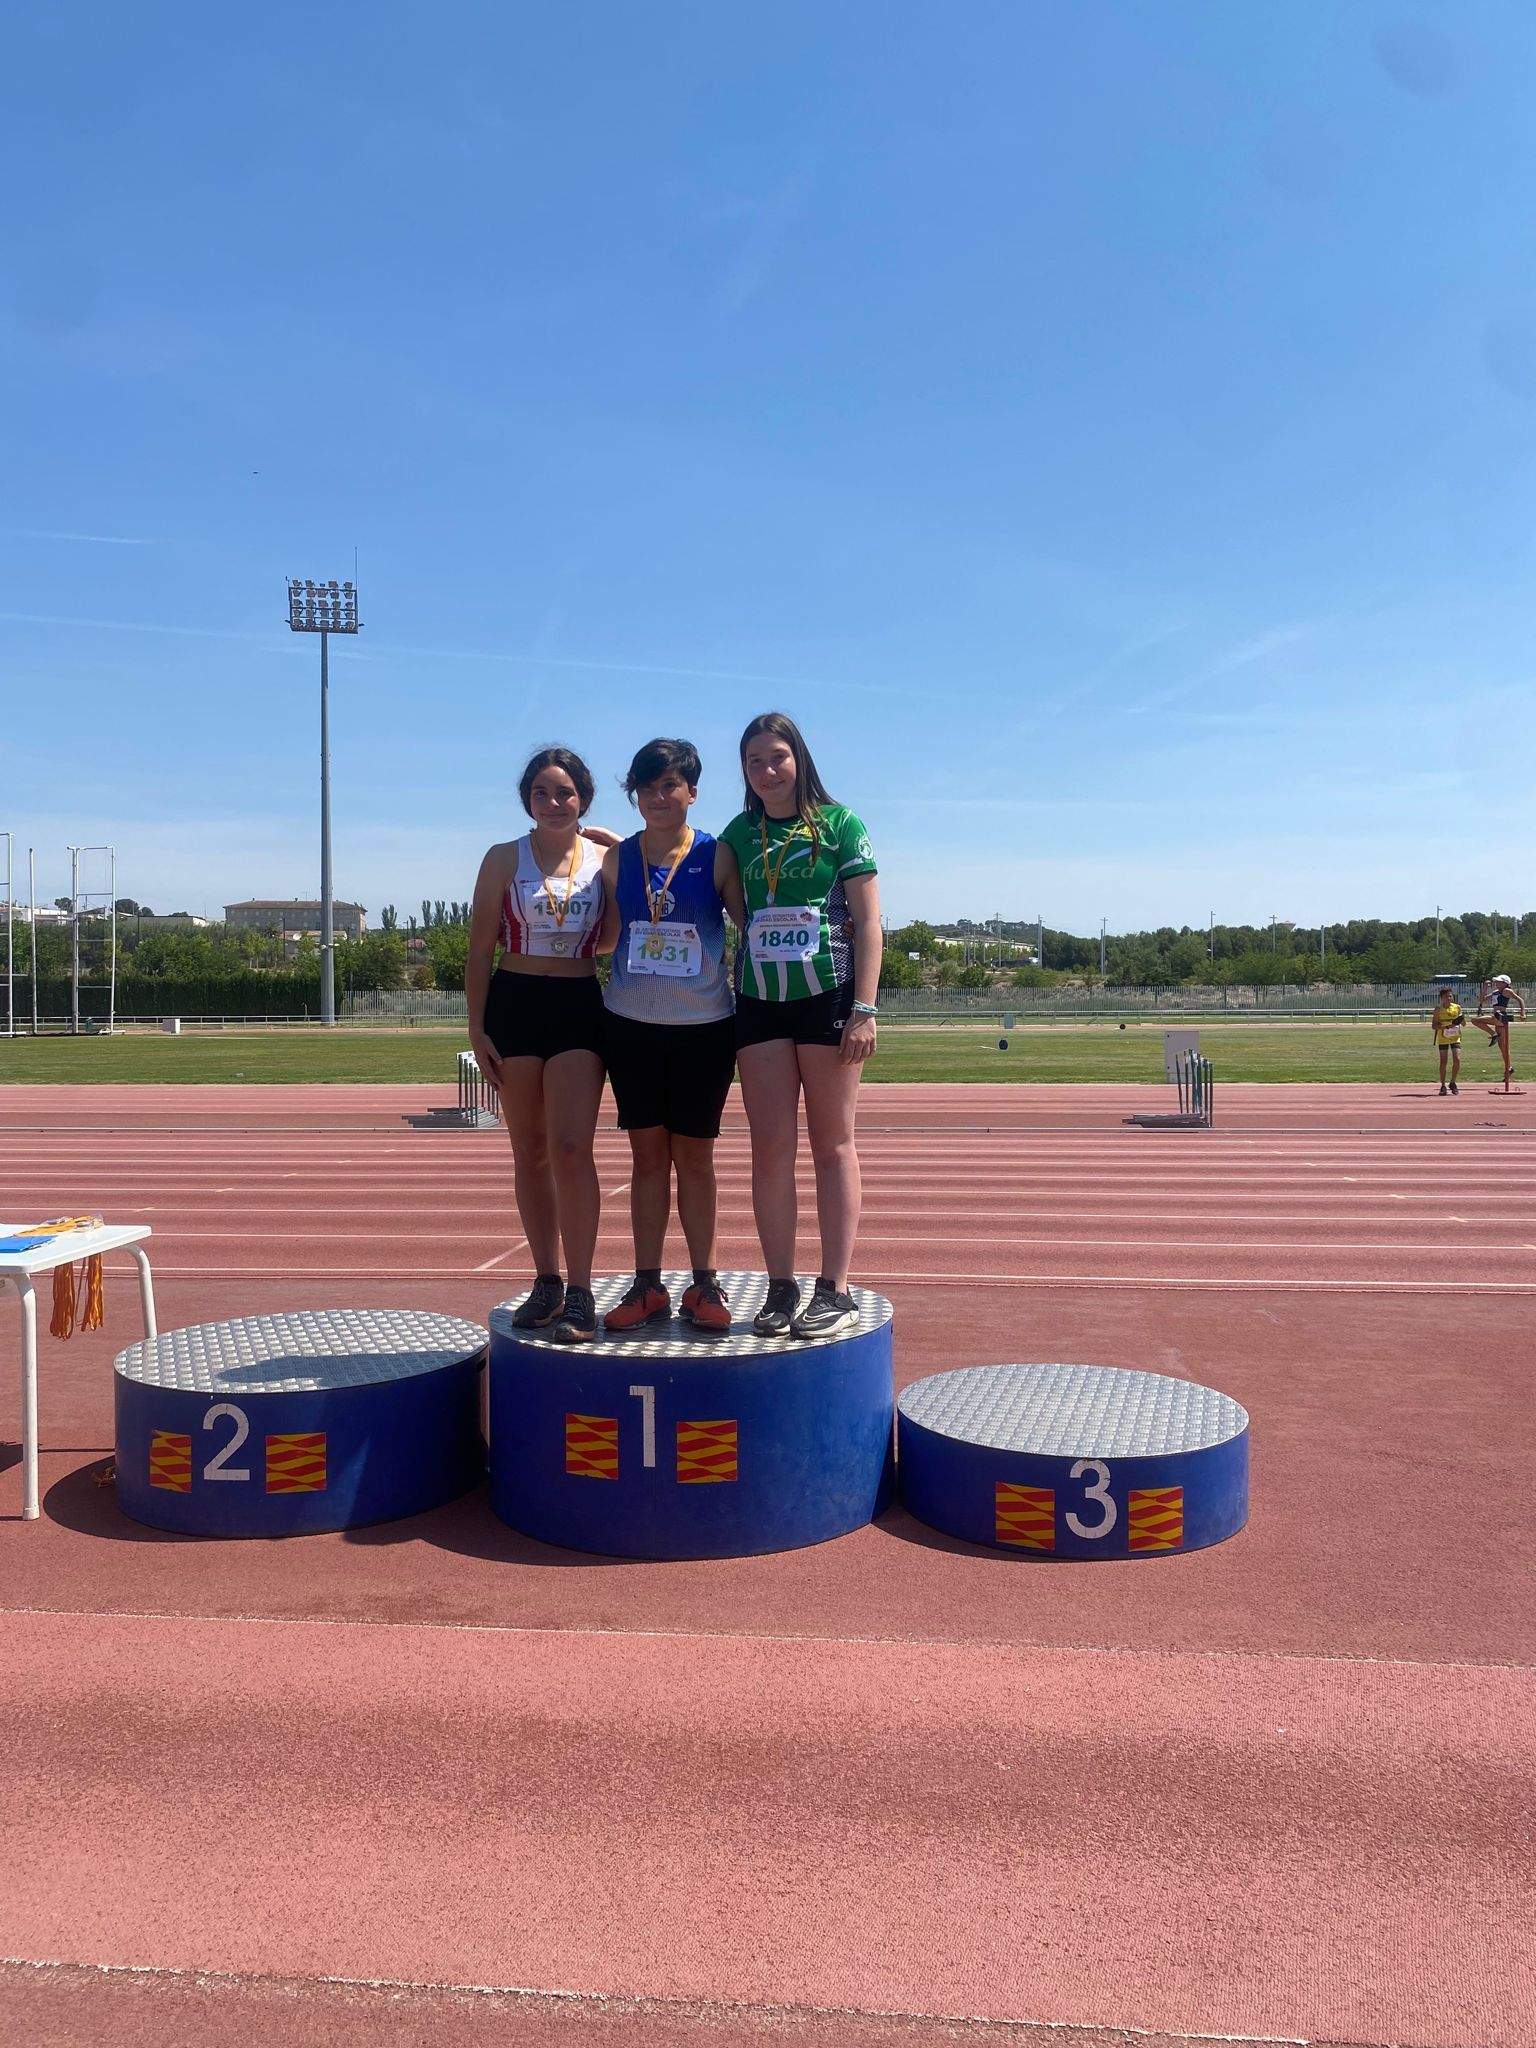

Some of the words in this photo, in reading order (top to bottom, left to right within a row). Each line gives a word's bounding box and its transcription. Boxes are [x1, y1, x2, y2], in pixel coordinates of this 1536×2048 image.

[759, 930, 809, 947] 1840
[203, 1403, 250, 1481] 2
[629, 1385, 656, 1468] 1
[1065, 1459, 1117, 1539] 3
